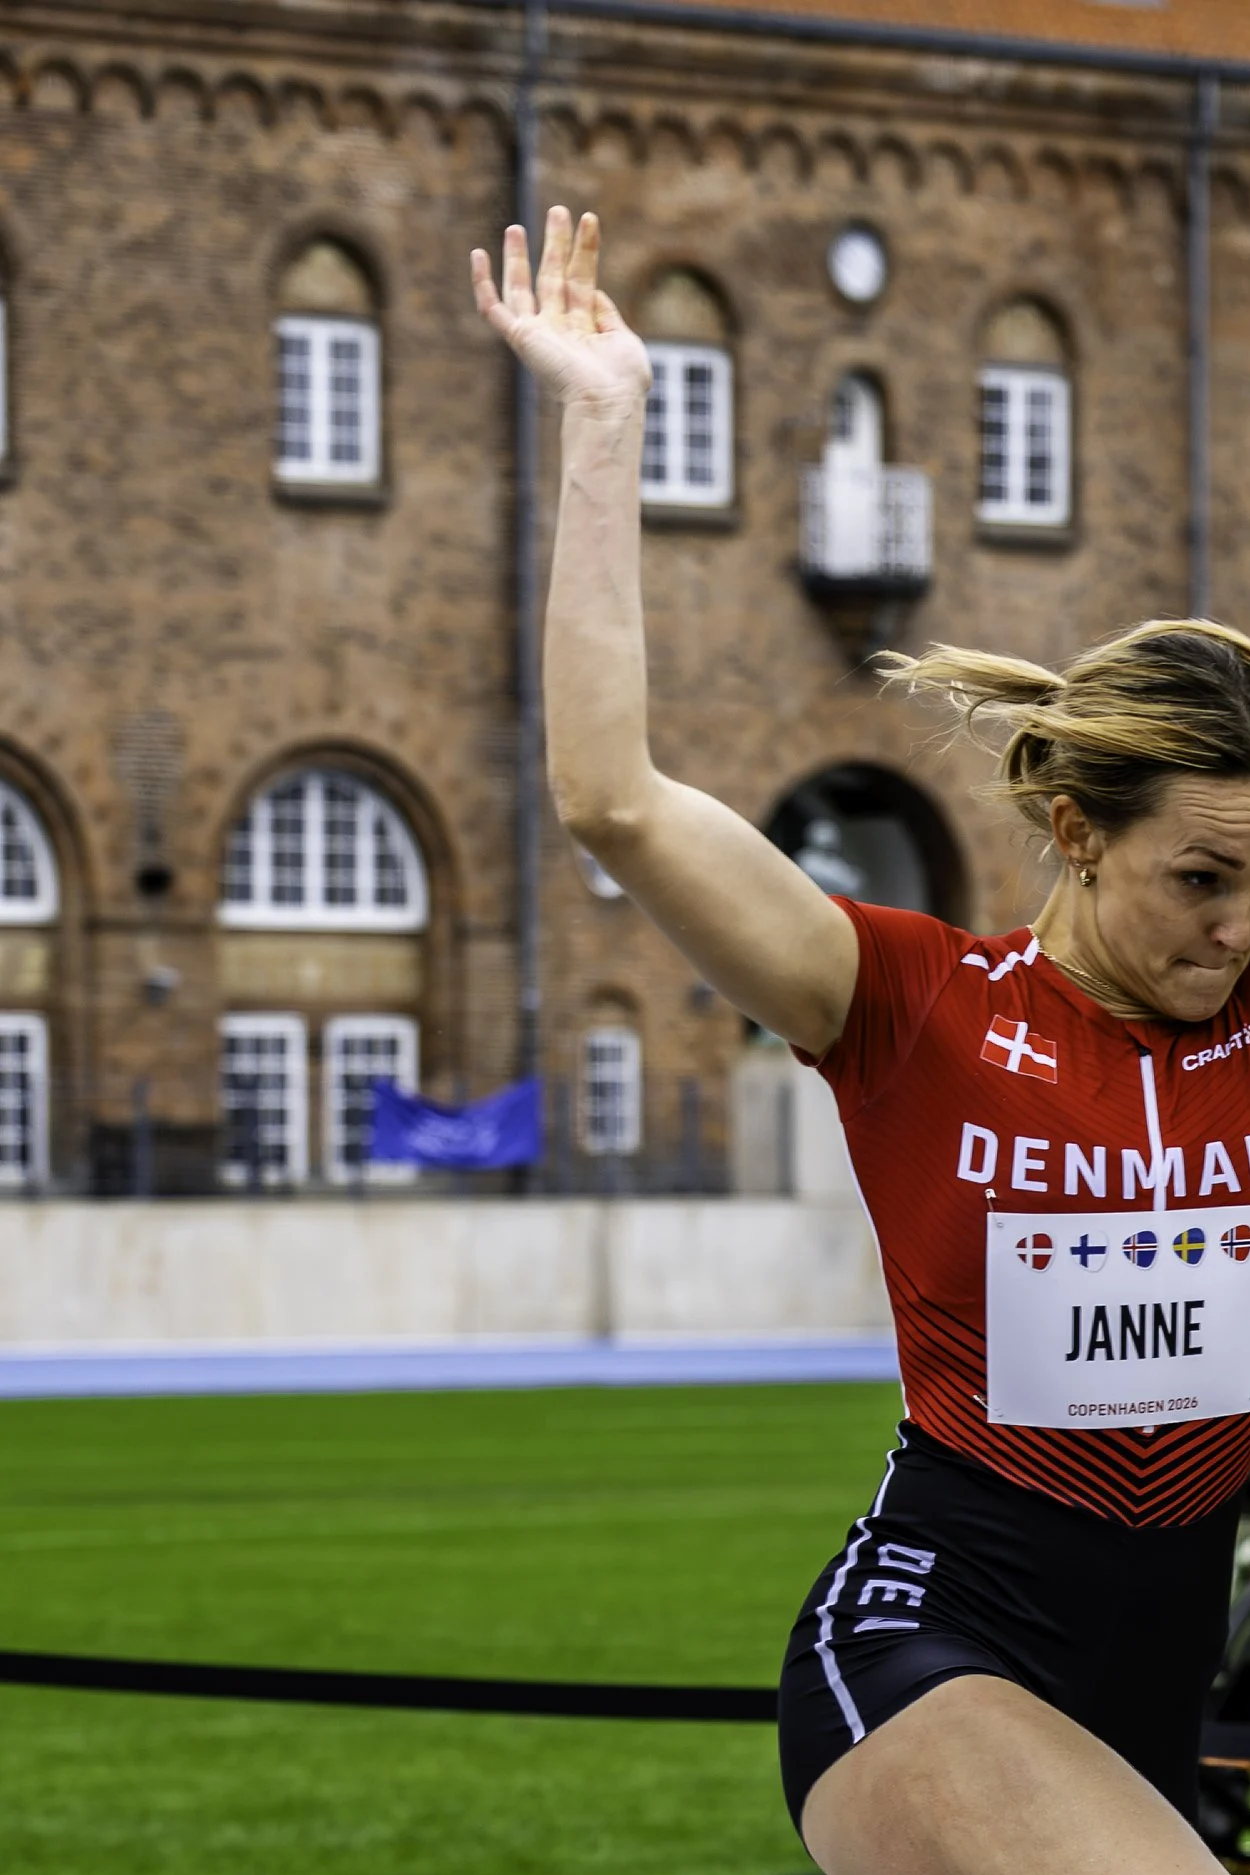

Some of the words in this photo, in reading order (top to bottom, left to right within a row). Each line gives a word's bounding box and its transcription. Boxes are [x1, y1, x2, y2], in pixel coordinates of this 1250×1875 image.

[1182, 1030, 1245, 1071] CRAFT
[1065, 1300, 1205, 1362] JANNE
[1067, 1400, 1164, 1417] COPENHAGEN
[1167, 1397, 1199, 1411] 2026
